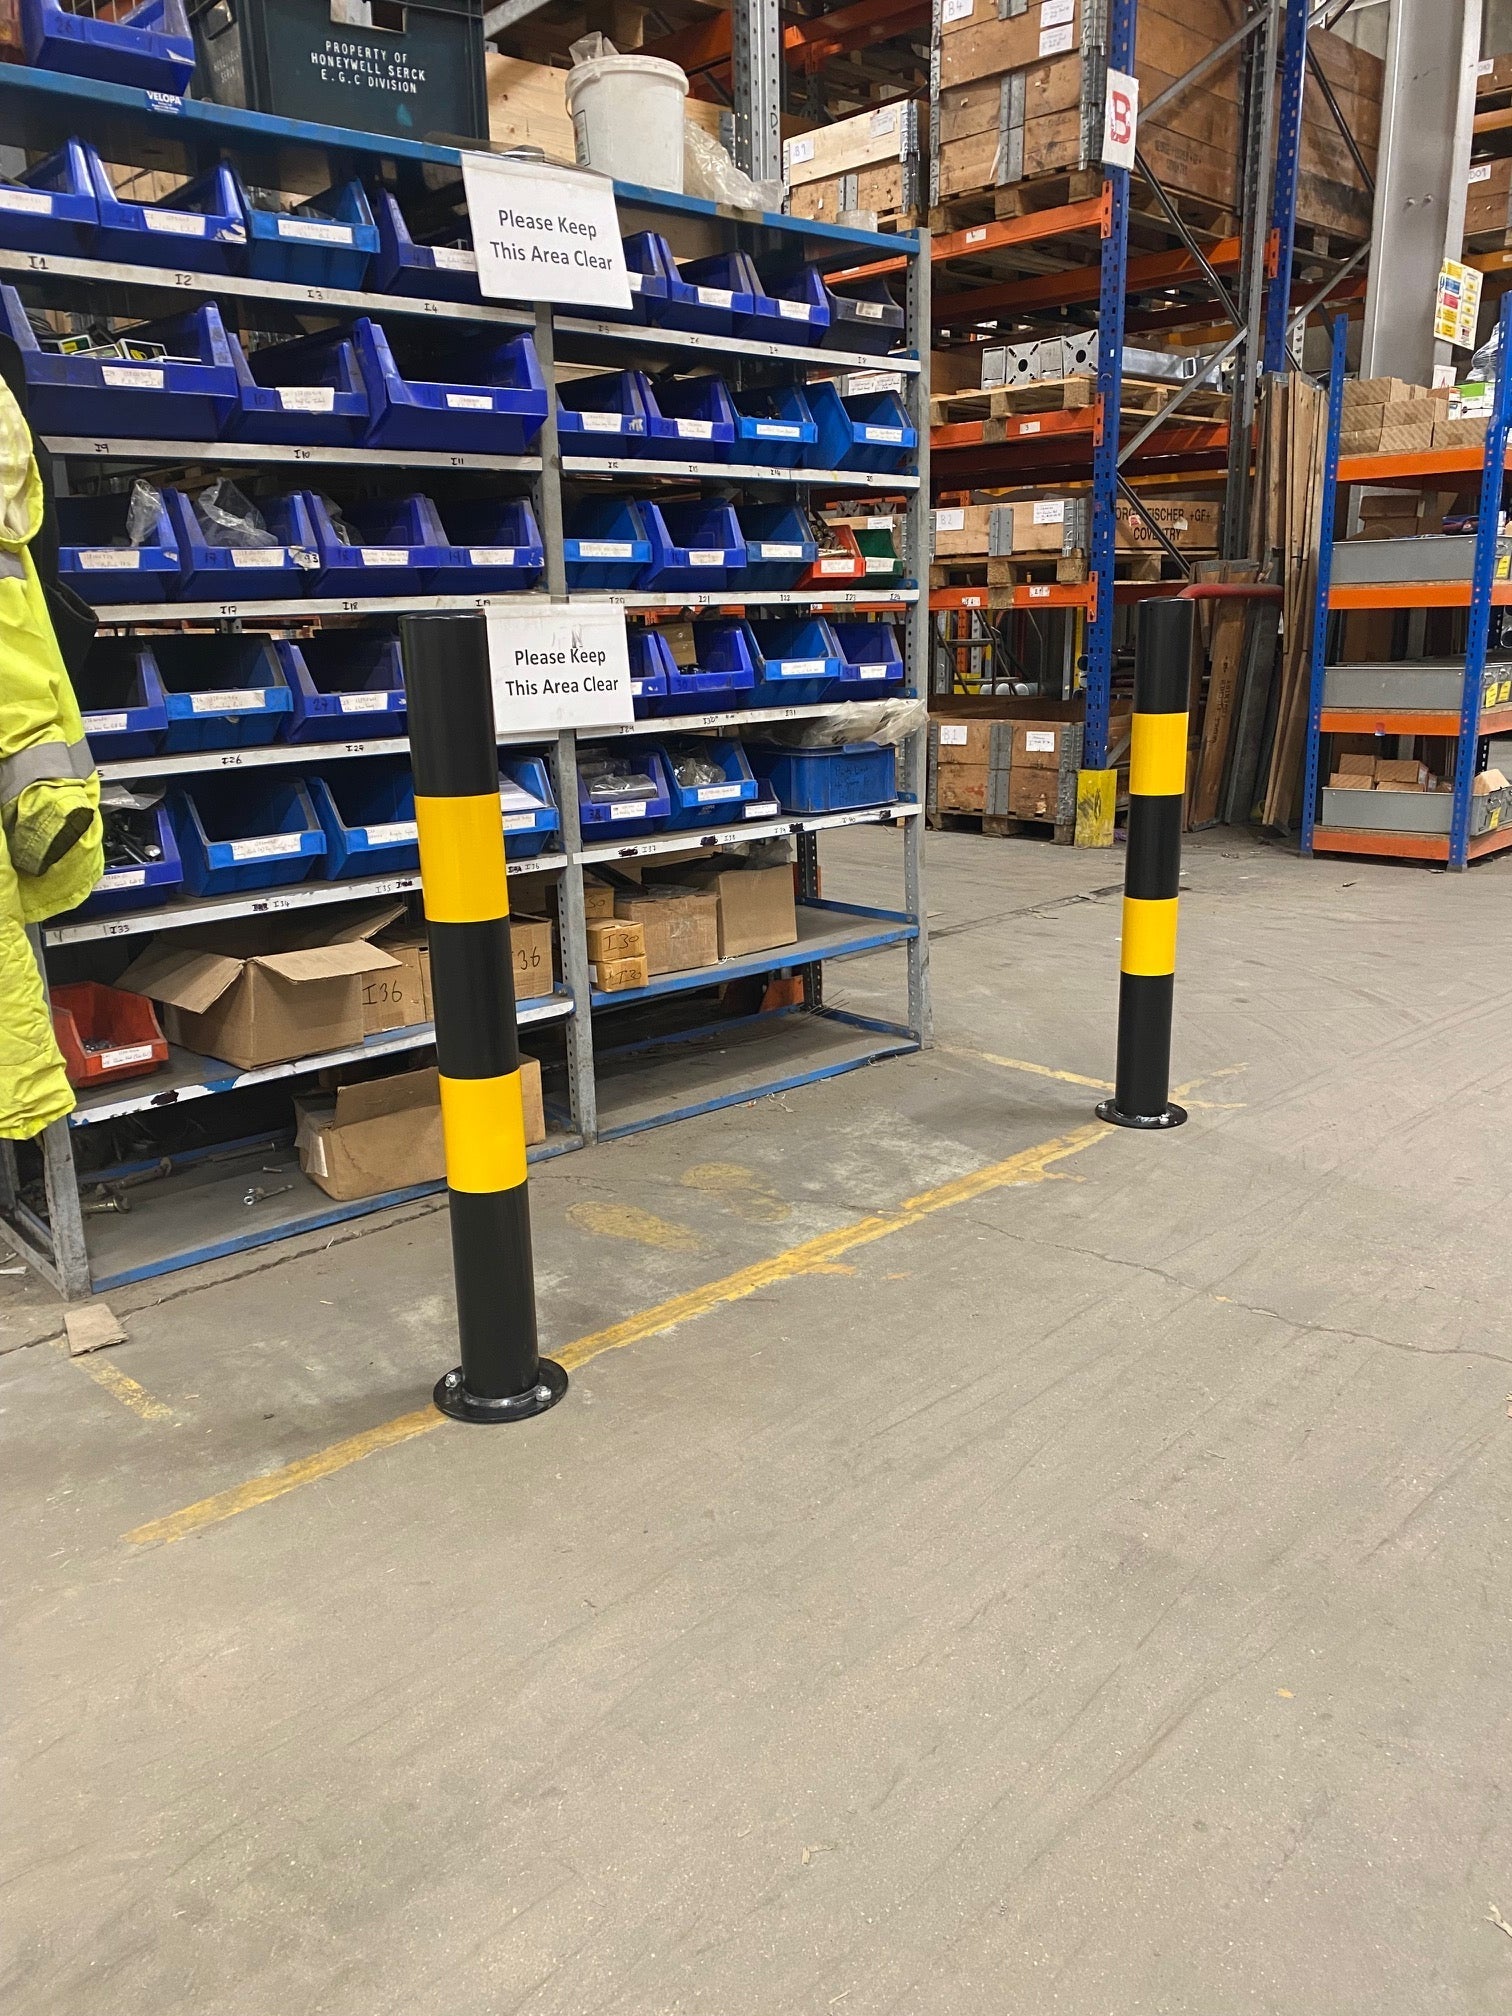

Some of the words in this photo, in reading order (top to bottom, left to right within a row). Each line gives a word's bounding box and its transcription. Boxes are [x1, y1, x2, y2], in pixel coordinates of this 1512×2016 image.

[325, 41, 387, 60] PROPERTY
[394, 52, 407, 64] OF
[311, 52, 381, 75] HONEYWELL
[388, 65, 426, 81] SERCK
[368, 76, 417, 93] DIVISION
[147, 91, 182, 105] VELOPA
[1111, 91, 1131, 144] B
[498, 209, 553, 231] Please
[557, 216, 597, 240] Keep
[28, 255, 49, 270] I1
[489, 241, 526, 261] This
[531, 245, 570, 265] Area
[574, 249, 613, 270] Clear
[174, 273, 193, 286] I2
[307, 289, 323, 300] I3
[424, 303, 438, 314] I4
[95, 443, 109, 453] I9
[294, 449, 311, 460] I10
[450, 457, 464, 467] I11
[1116, 506, 1140, 521] ORG
[1133, 527, 1181, 541] COVTRY
[514, 648, 566, 666] Please
[570, 647, 606, 666] Keep
[505, 679, 538, 696] This
[542, 678, 579, 695] Area
[583, 675, 619, 692] Clear
[221, 754, 243, 765] I26
[375, 886, 391, 894] I35
[273, 900, 290, 909] I34
[109, 924, 130, 935] I33
[602, 933, 640, 953] I30
[511, 946, 541, 971] 36
[362, 980, 403, 1006] I36
